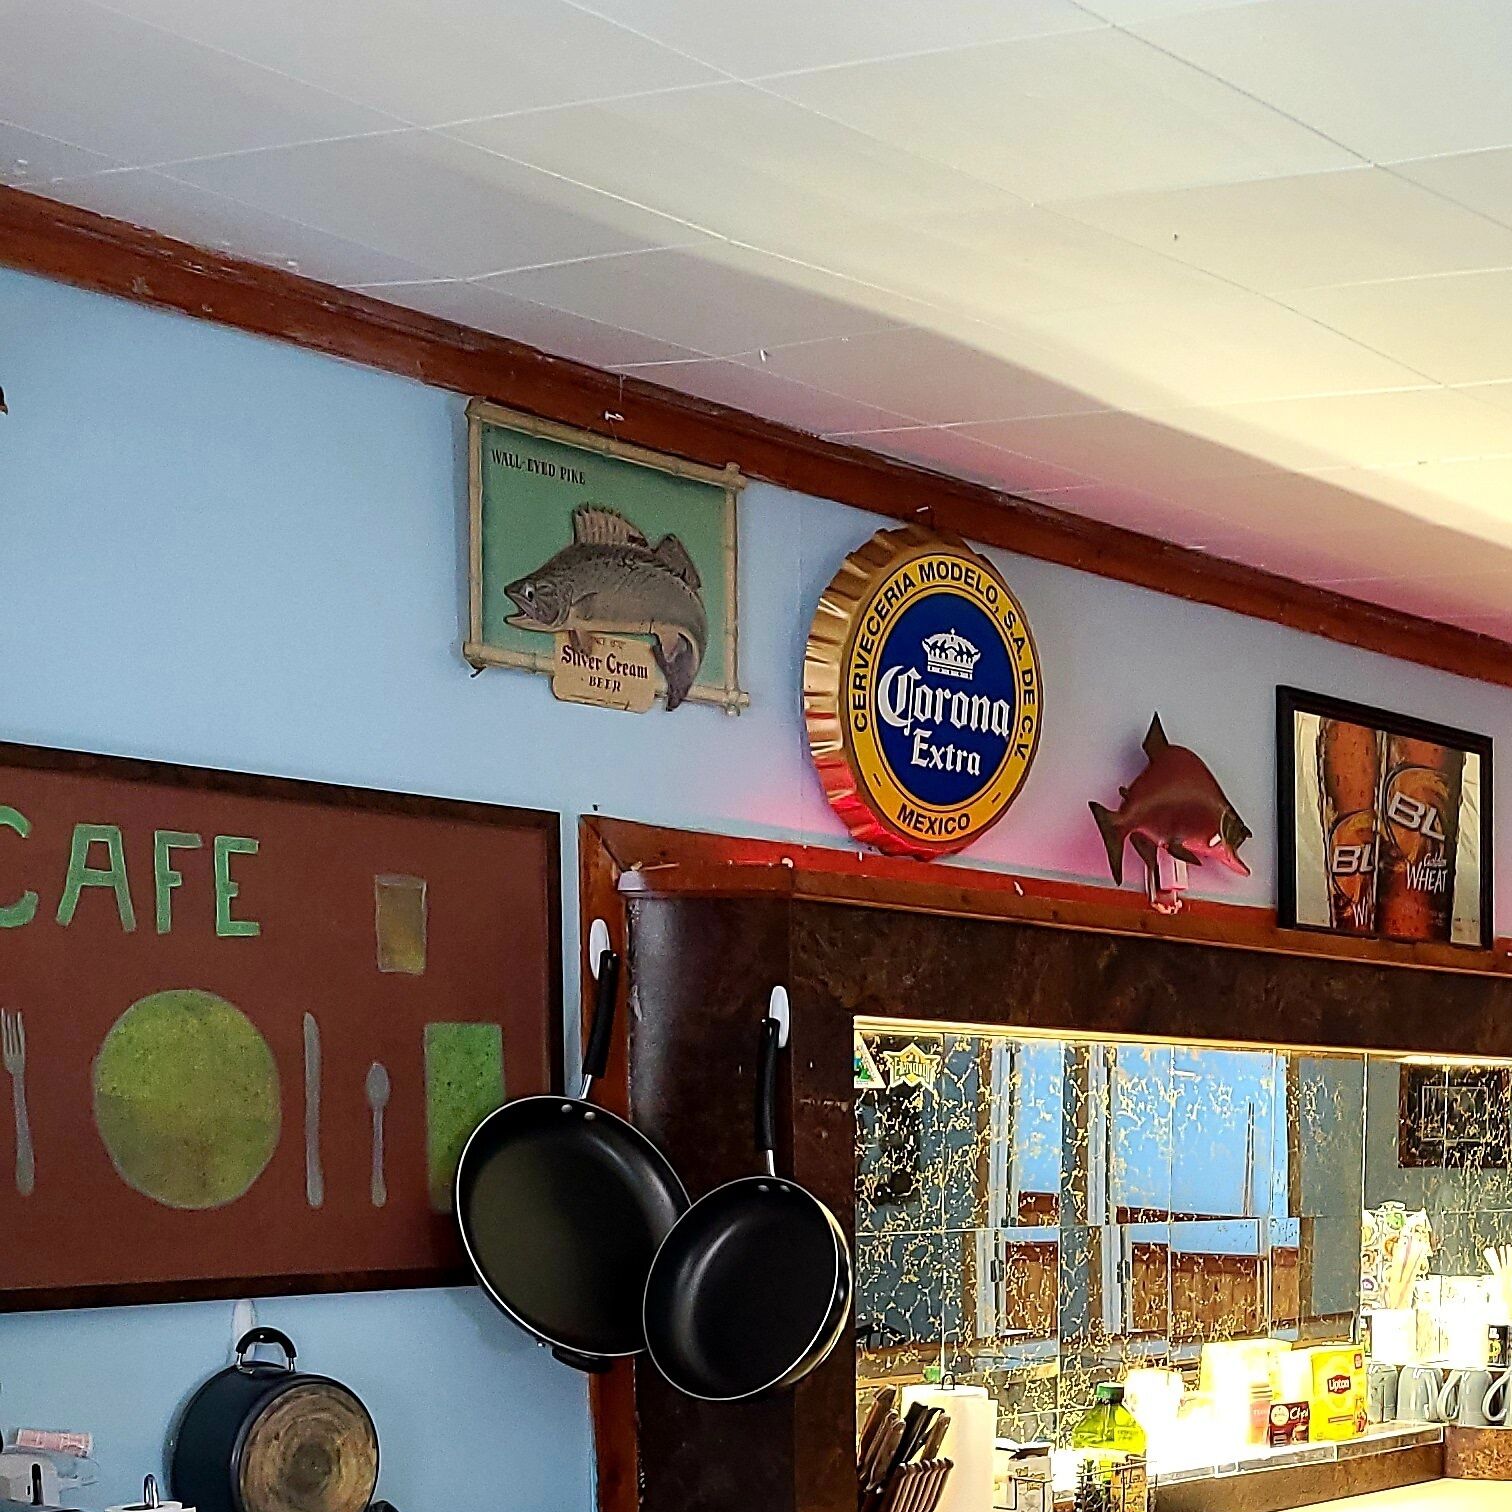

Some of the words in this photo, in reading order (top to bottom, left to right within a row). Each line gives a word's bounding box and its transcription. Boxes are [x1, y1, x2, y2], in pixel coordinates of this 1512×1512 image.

[491, 449, 556, 478] WALL-EYED
[560, 468, 586, 486] PIKE
[560, 645, 603, 672] Silver
[606, 653, 648, 680] Cream
[853, 572, 917, 733] CERVECERIA
[1021, 668, 1035, 705] DE
[588, 676, 622, 693] BEER
[877, 665, 1011, 737] Corona
[910, 728, 982, 777] Extra
[896, 802, 971, 837] MEXICO
[1406, 862, 1449, 893] WHEAT
[1328, 1378, 1350, 1392] Lipton
